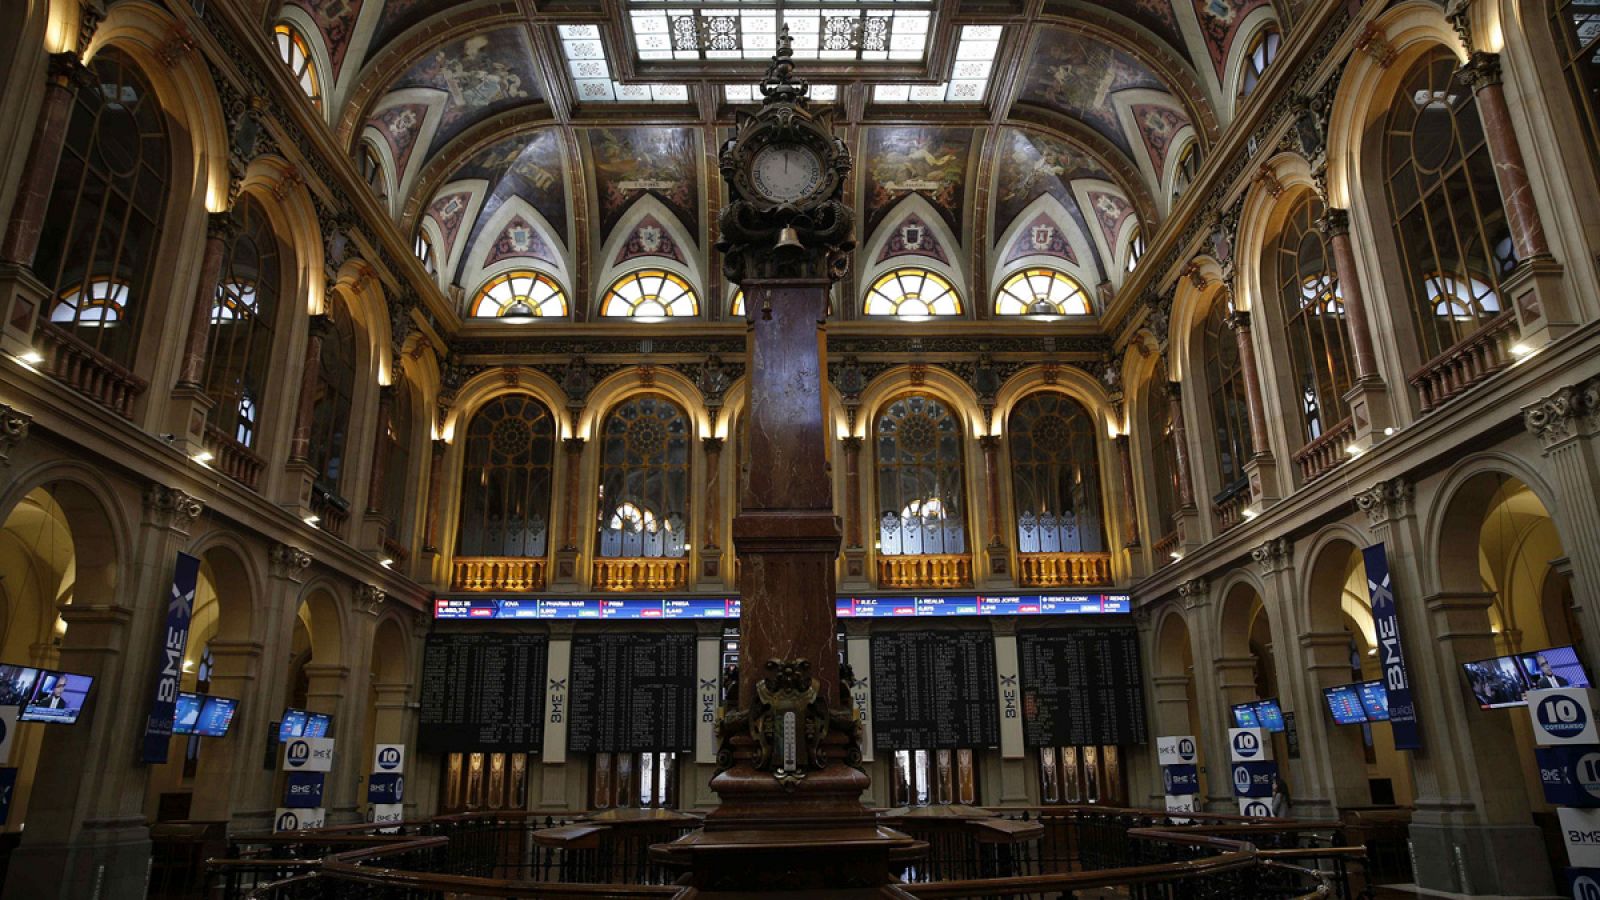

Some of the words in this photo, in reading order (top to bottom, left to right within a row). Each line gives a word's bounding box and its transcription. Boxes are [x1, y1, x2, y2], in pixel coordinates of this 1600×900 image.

[1378, 615, 1406, 691] BME
[157, 626, 185, 702] BME
[551, 694, 564, 723] BME
[703, 693, 715, 723] BME
[1004, 689, 1017, 719] BME
[1545, 701, 1578, 723] 10
[291, 743, 307, 758] 10
[1182, 742, 1193, 753] 10
[1239, 735, 1255, 749] 10
[383, 750, 397, 762] 10
[1541, 768, 1561, 782] BME
[281, 815, 296, 829] 10
